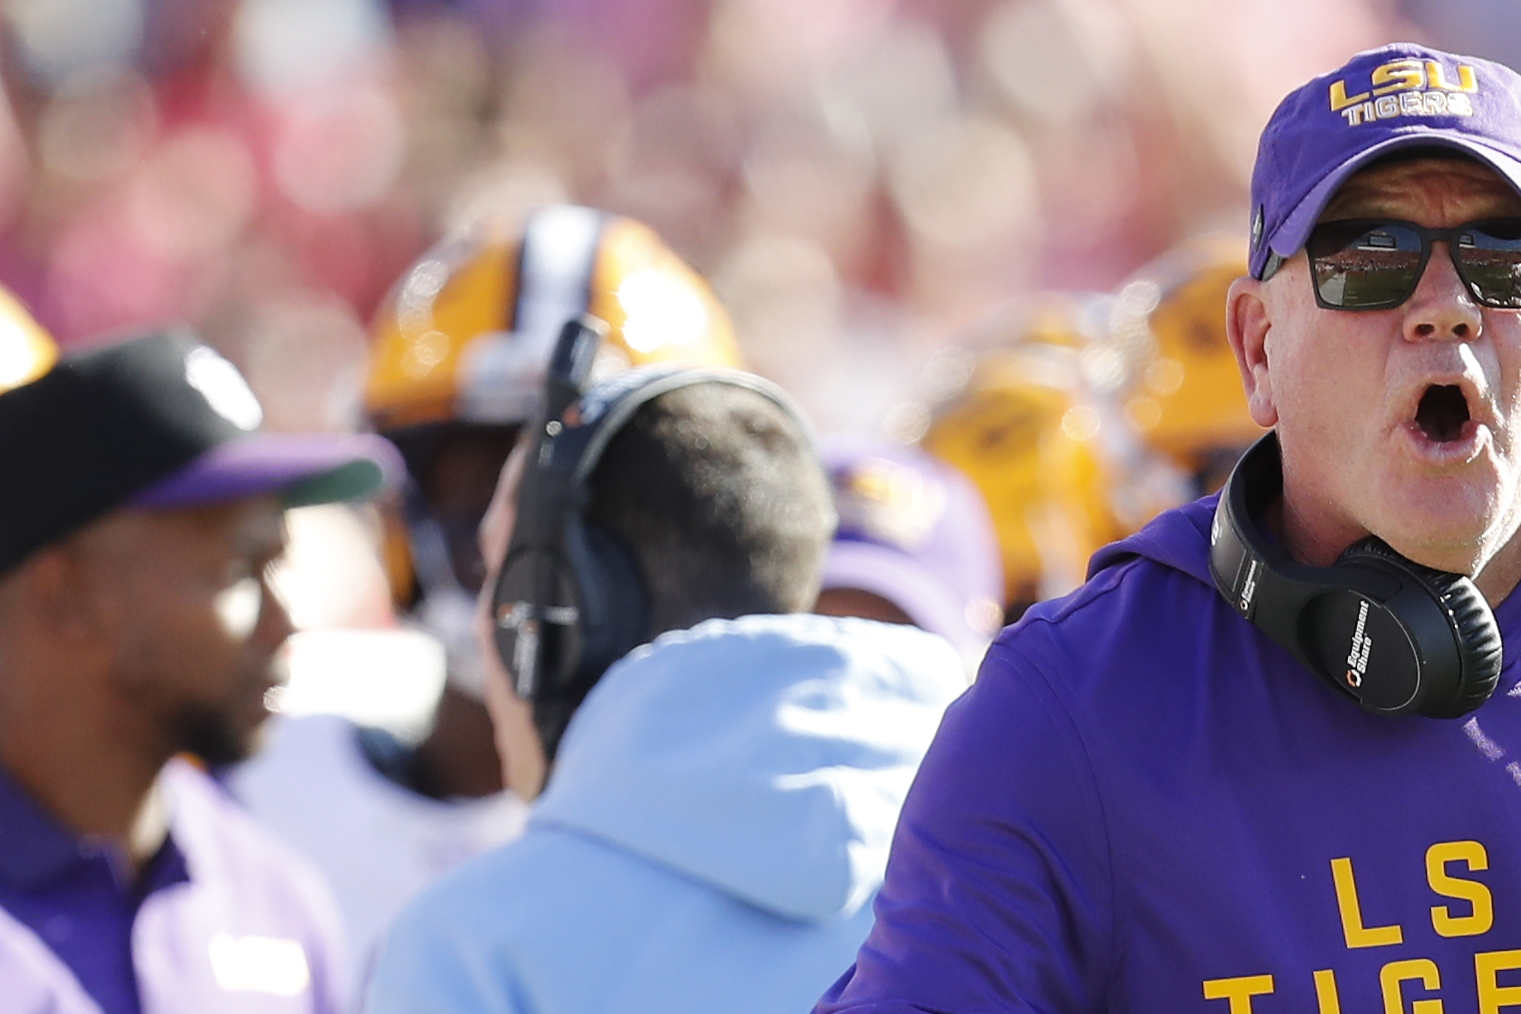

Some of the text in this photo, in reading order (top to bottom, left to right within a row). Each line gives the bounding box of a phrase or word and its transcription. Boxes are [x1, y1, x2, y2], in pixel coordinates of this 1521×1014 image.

[1330, 60, 1478, 111] LSU
[1341, 91, 1474, 126] TIGERS
[1347, 600, 1369, 668] Equipment
[1357, 636, 1372, 674] Share
